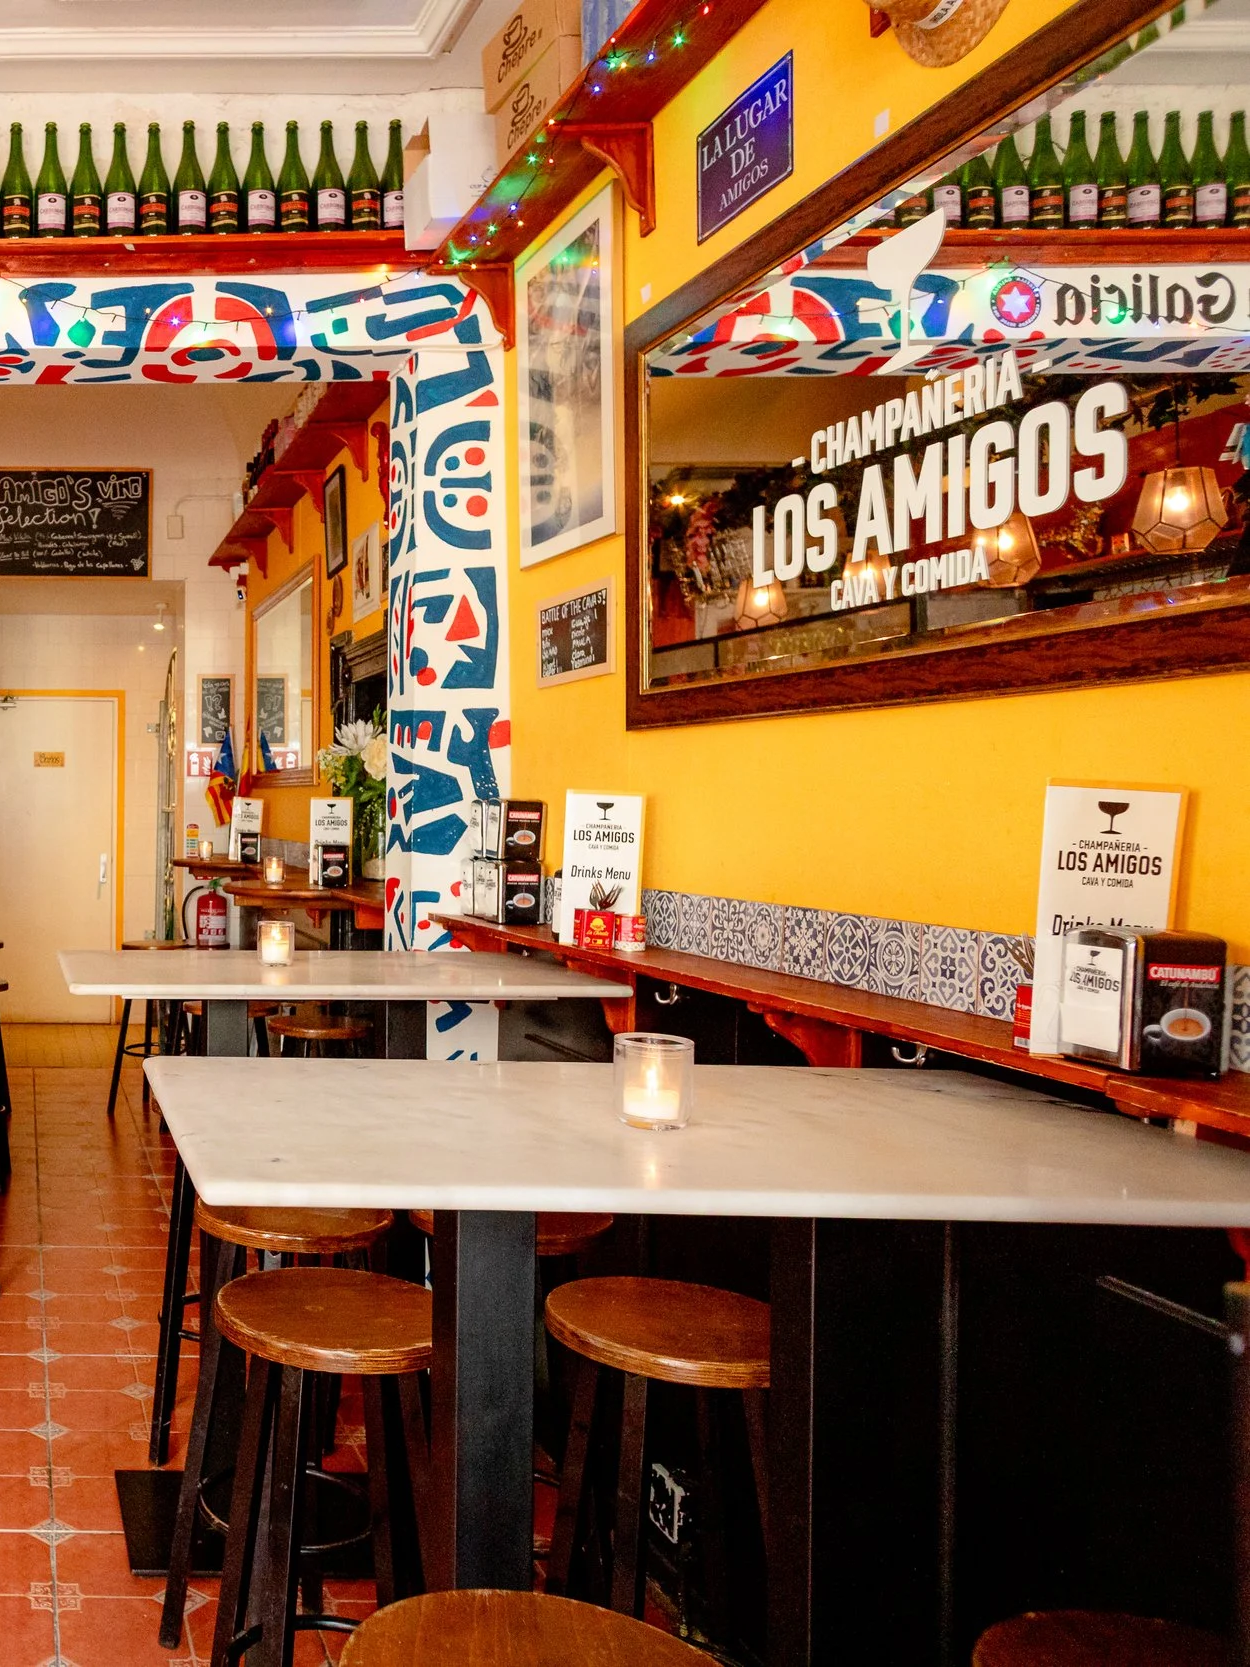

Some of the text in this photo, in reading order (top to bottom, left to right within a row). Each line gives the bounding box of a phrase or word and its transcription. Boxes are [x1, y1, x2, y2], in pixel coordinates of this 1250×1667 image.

[702, 78, 788, 172] LA LUGAR
[730, 137, 756, 179] DE
[718, 158, 769, 212] AMIGOS
[810, 349, 1024, 475] CHAMPAÑERIA
[752, 381, 1129, 589] LOS AMIGOS
[830, 545, 990, 612] CAVA Y COMIDA
[541, 605, 560, 624] BATTLE
[561, 603, 569, 619] OF
[570, 598, 582, 616] THE
[573, 829, 635, 844] LOS AMIGOS
[1078, 839, 1141, 853] CHAMPAÑERIA
[571, 865, 631, 881] Drinks Menu
[1057, 850, 1163, 876] LOS AMIGOS
[1081, 876, 1134, 889] CAVA Y COMIDA
[1083, 973, 1120, 992] AMIGOS
